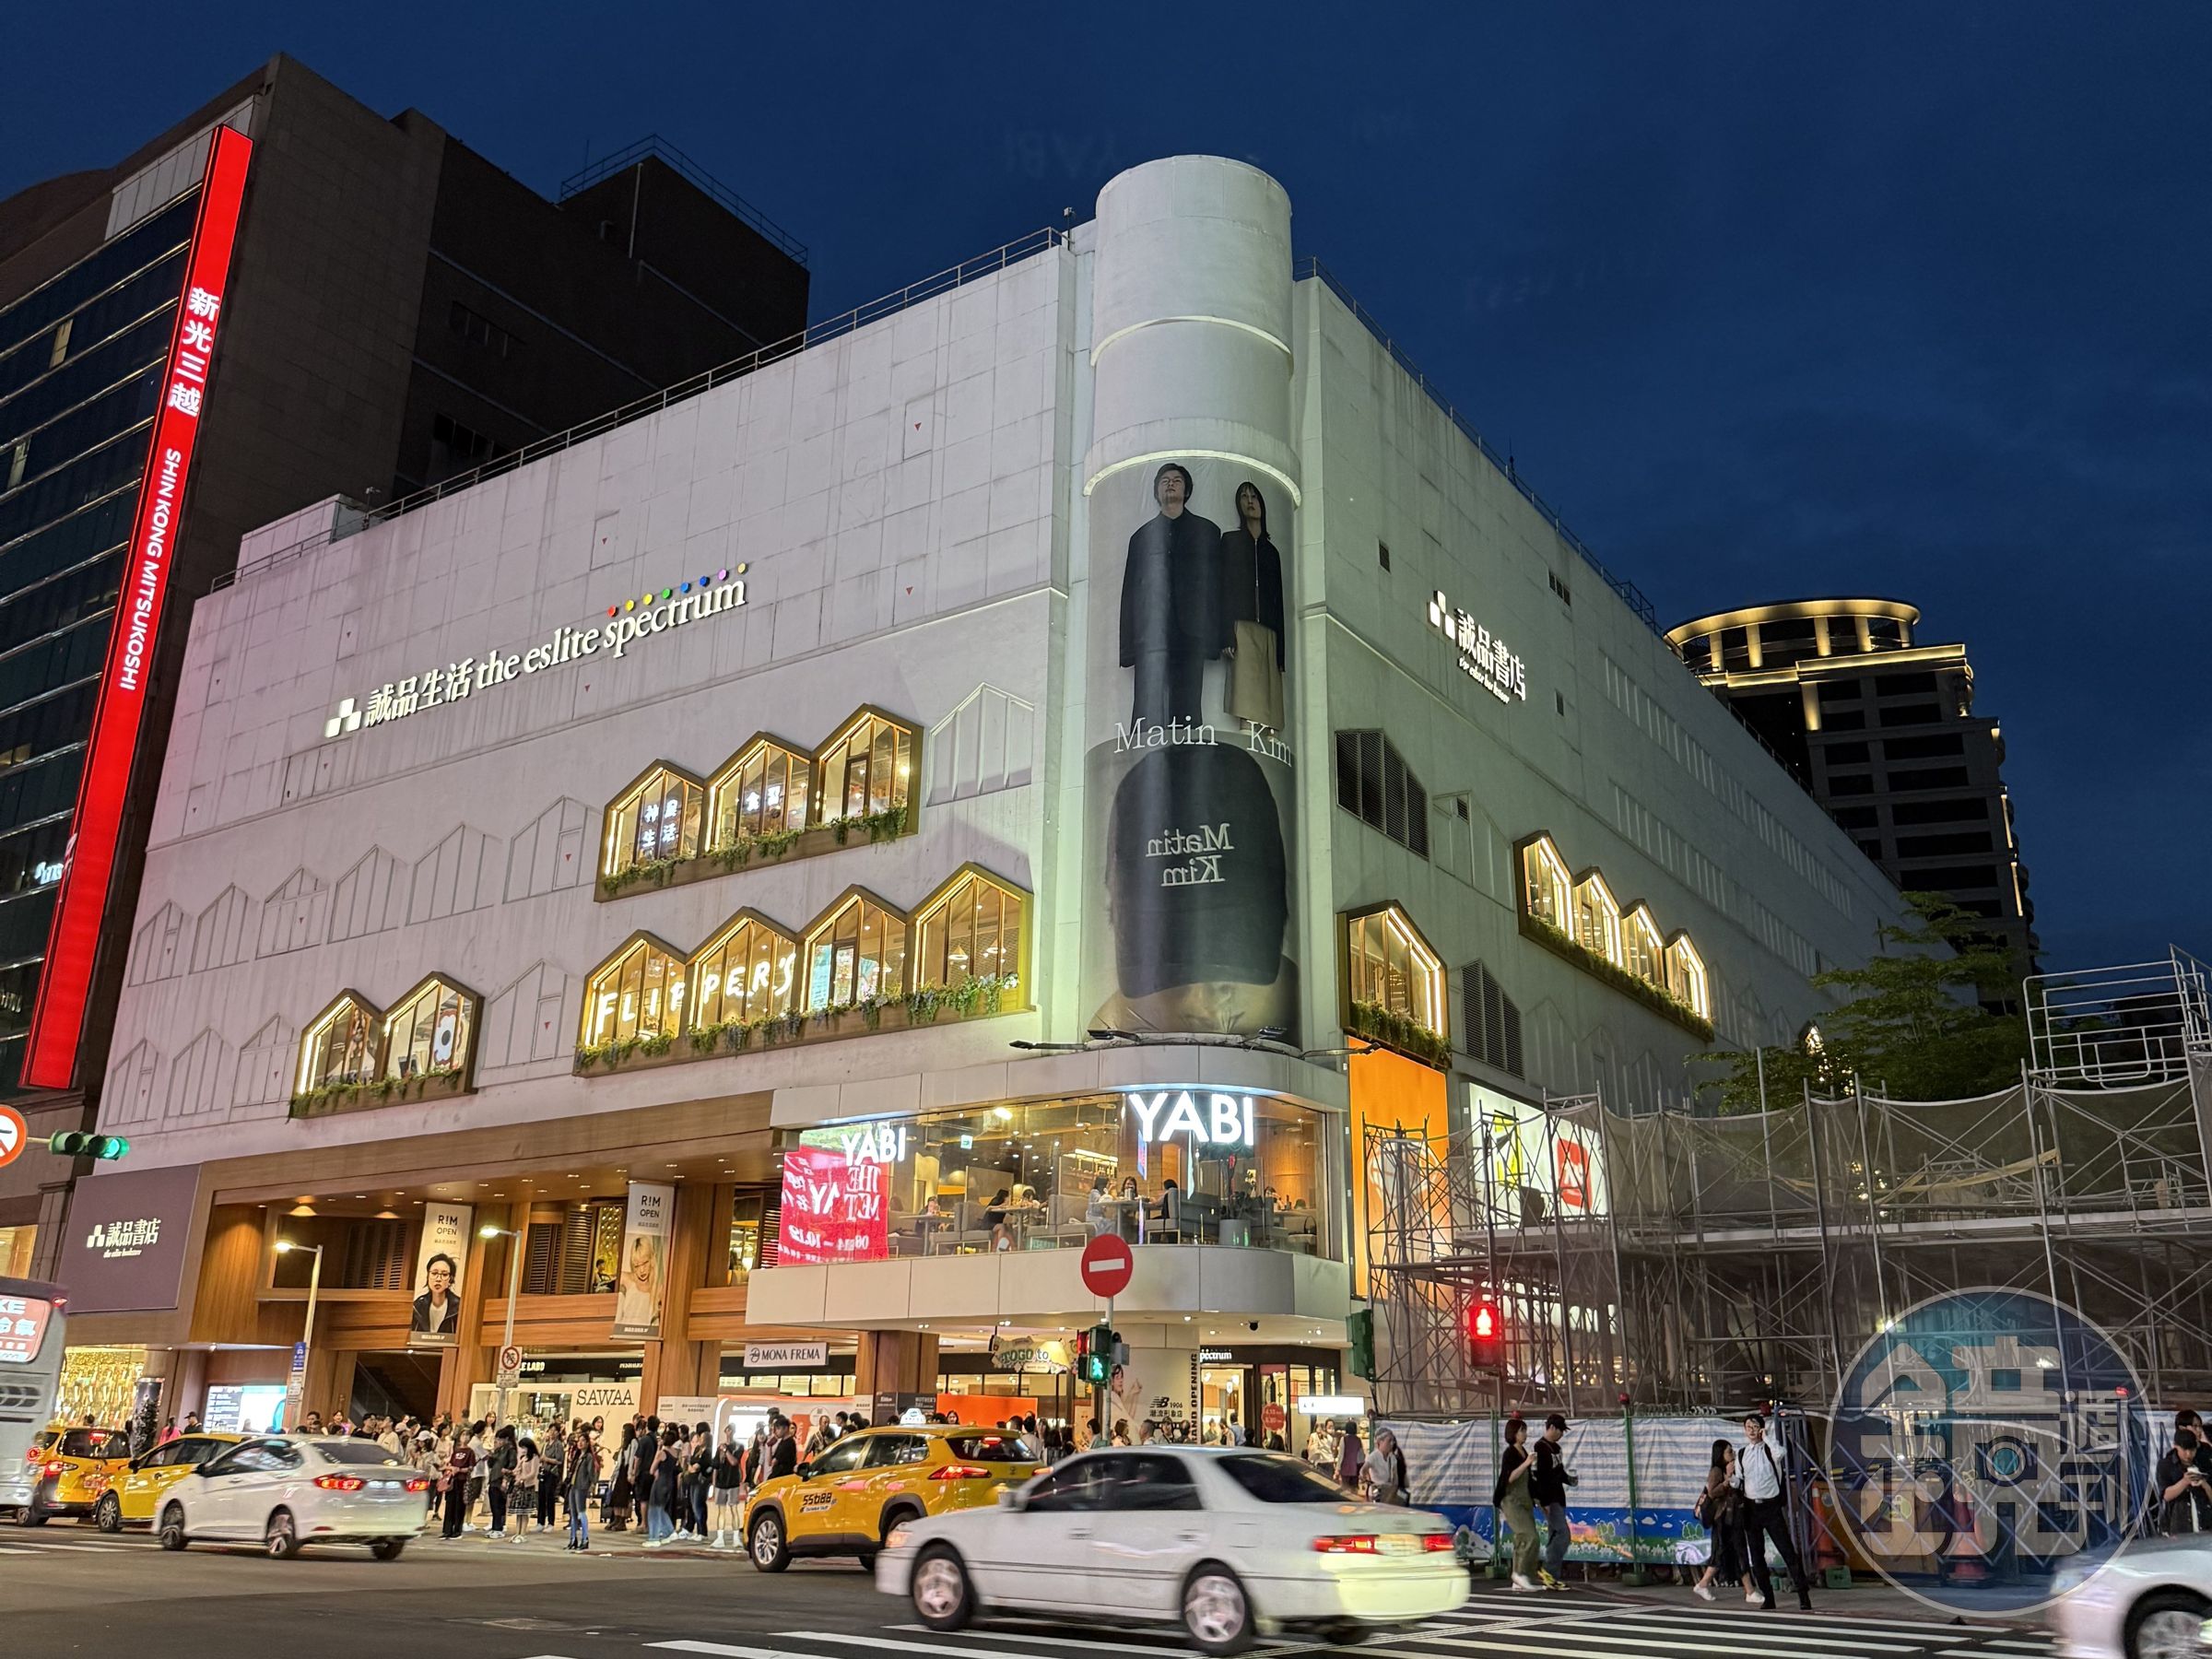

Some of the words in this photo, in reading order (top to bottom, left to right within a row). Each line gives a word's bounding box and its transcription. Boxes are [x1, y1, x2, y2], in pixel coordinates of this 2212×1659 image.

[167, 288, 220, 418] 新光三越
[158, 448, 182, 498] SHIN
[147, 498, 172, 559] KONG
[119, 560, 160, 691] MITSUKOSHI
[365, 658, 475, 727] 誠品生活
[477, 650, 522, 689] the
[523, 626, 599, 673] eslite
[604, 579, 747, 658] spectrum
[1113, 715, 1218, 754] Matin
[1246, 720, 1291, 768] Kim
[1128, 1090, 1254, 1146] YABI
[841, 1126, 907, 1166] YABI
[105, 1218, 162, 1248] 誠品書店
[436, 1228, 458, 1236] OPEN
[640, 1209, 660, 1218] OPEN
[761, 1349, 788, 1360] MONA
[790, 1347, 820, 1360] FREMA
[1199, 1352, 1232, 1362] pectrum
[576, 1389, 634, 1406] SAWAA
[803, 1492, 832, 1506] 55688
